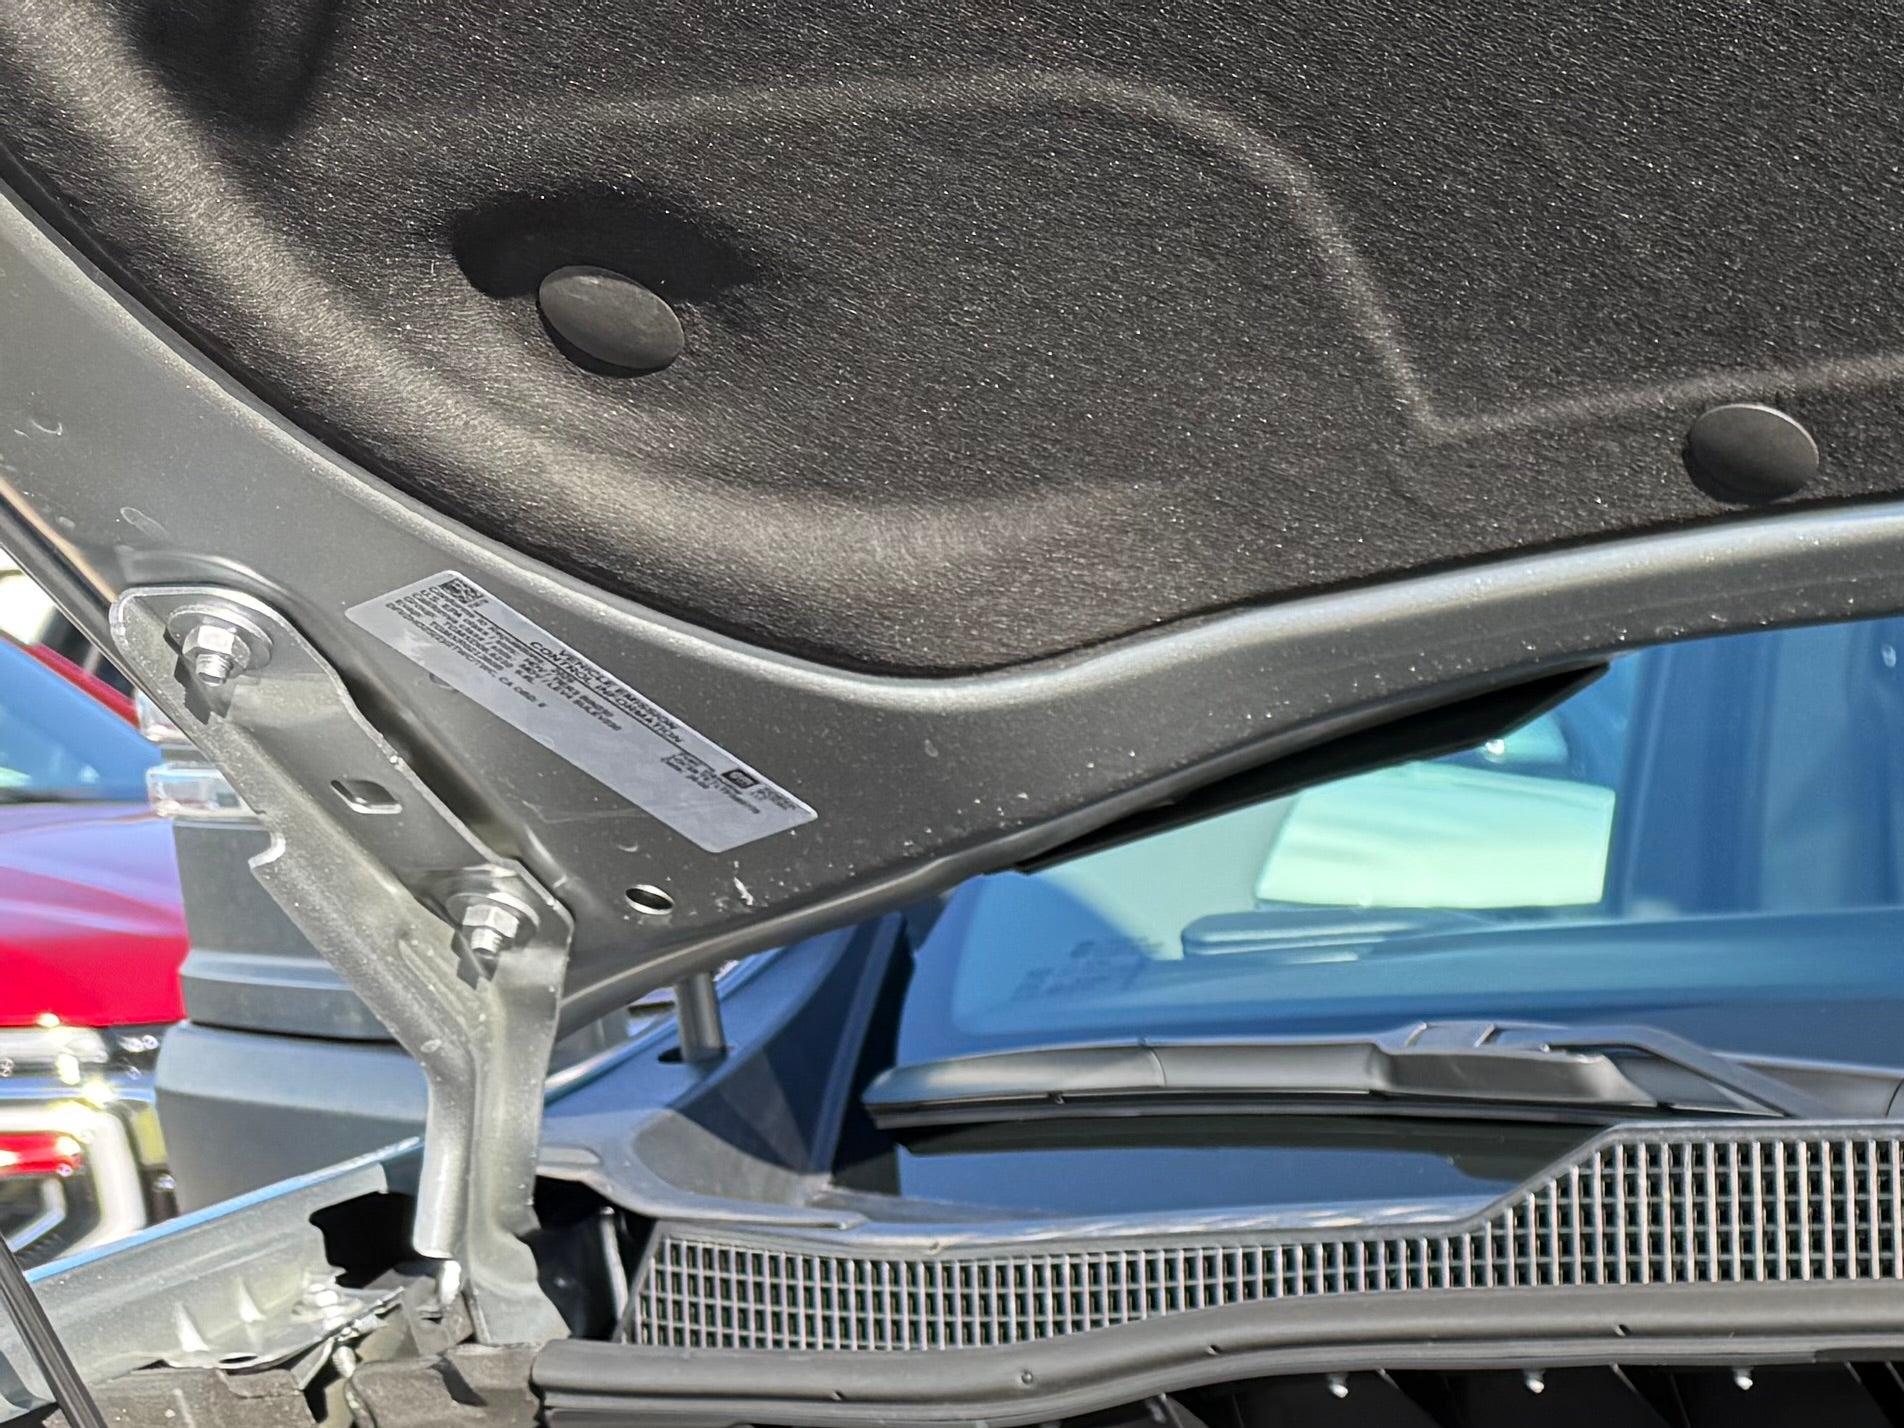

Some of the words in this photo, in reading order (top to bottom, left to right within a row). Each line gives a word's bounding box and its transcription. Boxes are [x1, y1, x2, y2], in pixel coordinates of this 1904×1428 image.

[529, 641, 594, 682] CONTROL
[595, 685, 684, 742] INFORMATION
[557, 650, 615, 686] VEHICLE
[615, 688, 679, 729] EMISSION
